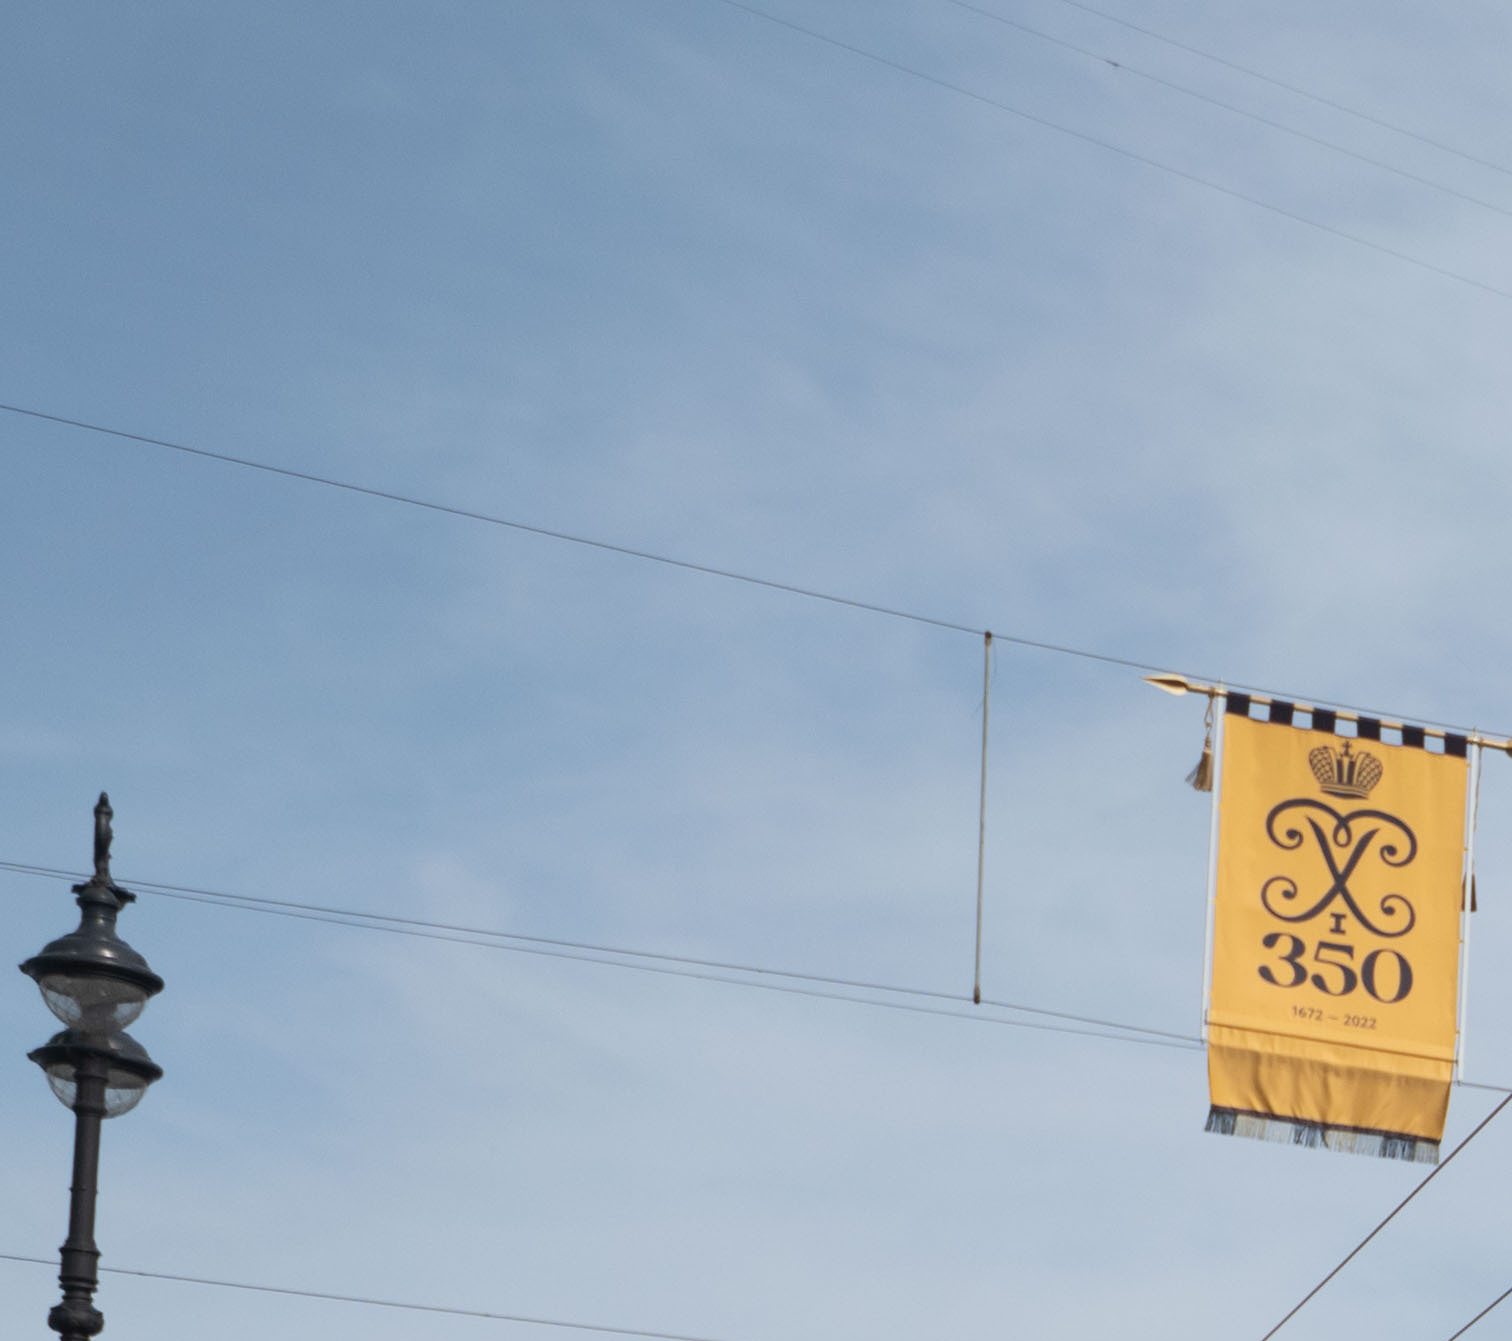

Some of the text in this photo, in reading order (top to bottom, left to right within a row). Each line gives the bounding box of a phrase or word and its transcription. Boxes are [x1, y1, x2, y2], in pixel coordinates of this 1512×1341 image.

[1258, 932, 1414, 1004] 350
[1292, 1005, 1324, 1022] 1672
[1343, 1014, 1377, 1030] 2022
